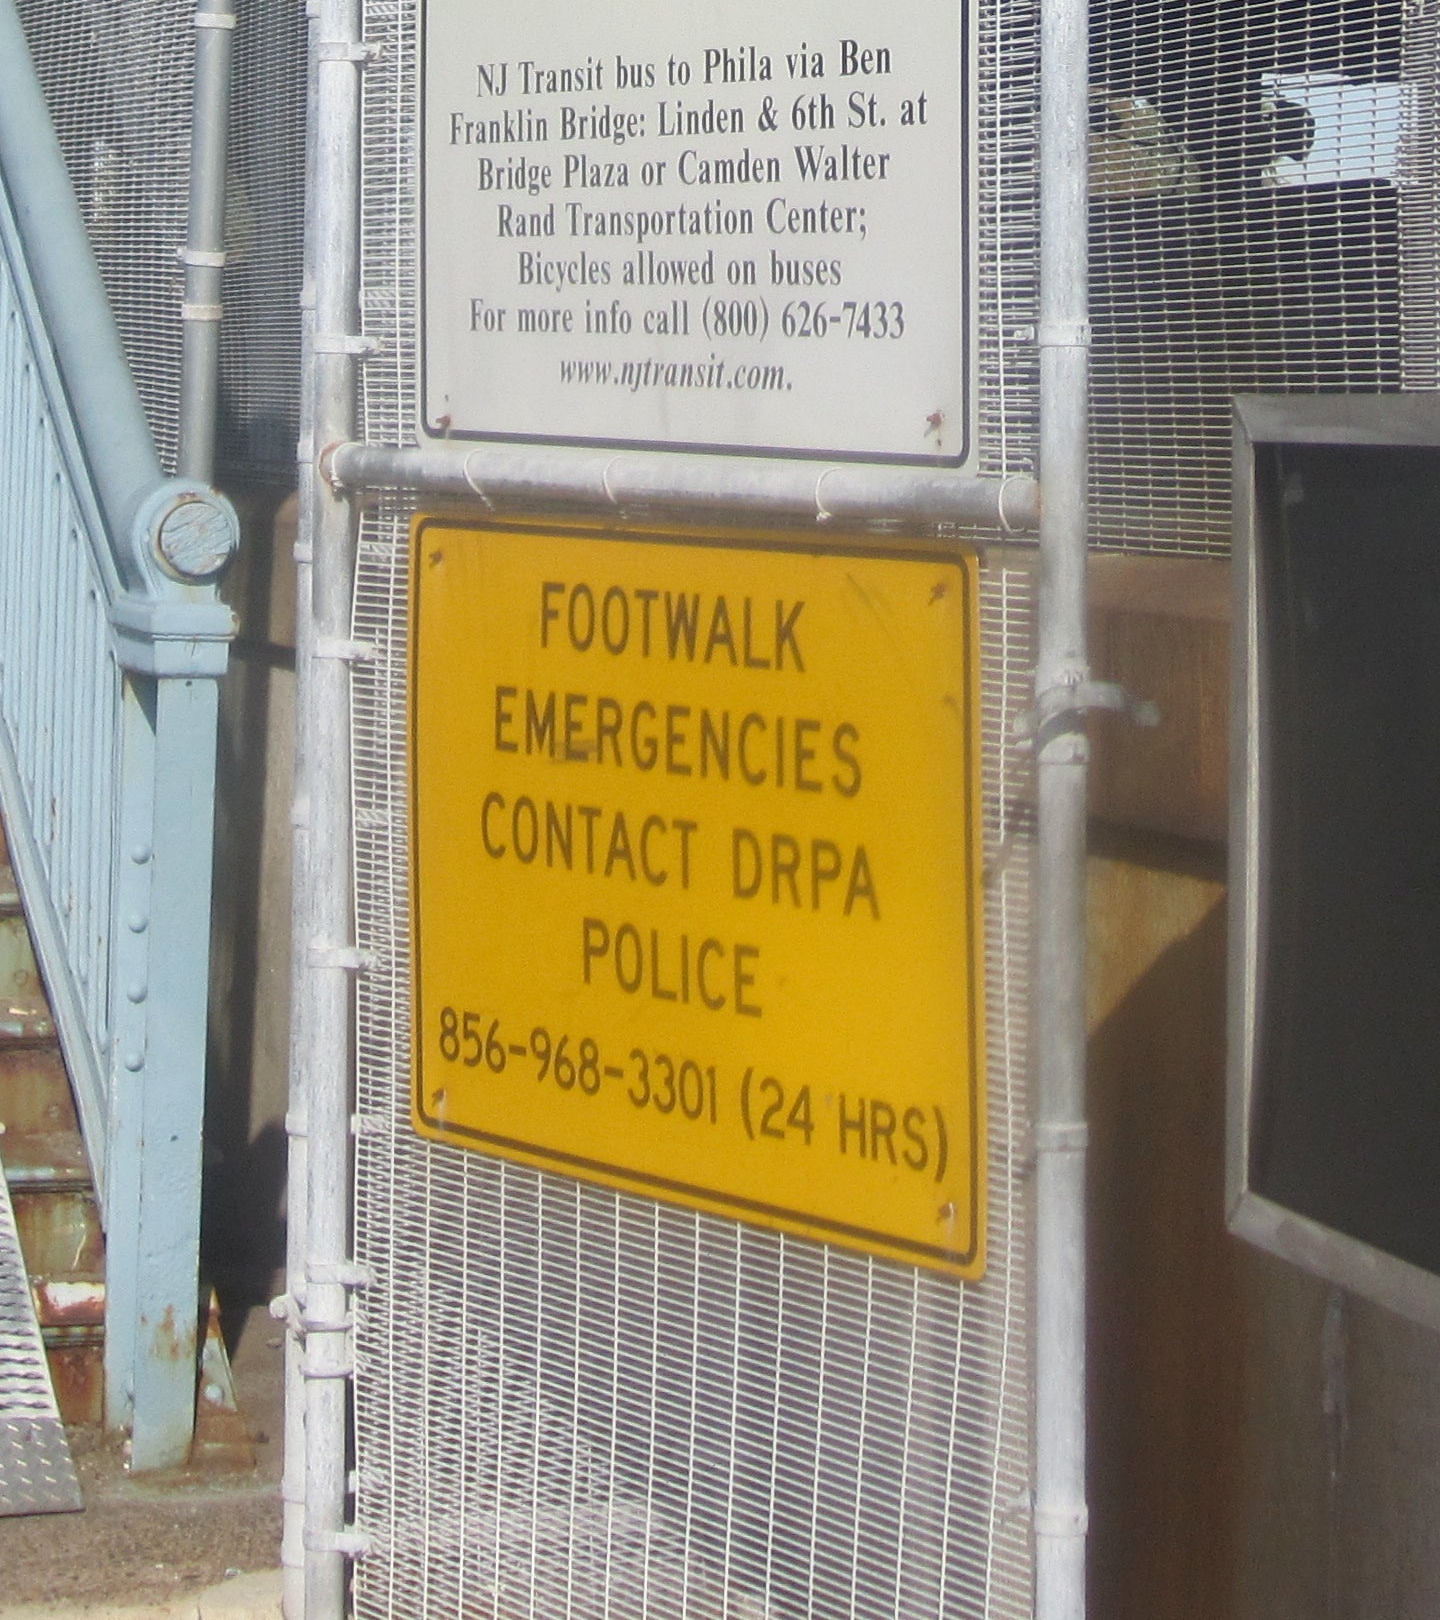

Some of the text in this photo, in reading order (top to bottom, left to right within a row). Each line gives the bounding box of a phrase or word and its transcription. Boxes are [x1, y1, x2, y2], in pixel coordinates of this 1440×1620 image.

[477, 40, 890, 97] NJ Transit bus to Phila via Ben
[450, 91, 927, 145] Franklin Bridge: Linden & 6th St. at
[479, 144, 890, 196] Bridge Plaza or Camden Walter
[498, 198, 866, 244] Rand Transportation Center;
[519, 250, 841, 293] Bicycles allowed on buses
[471, 296, 904, 342] For more info call (800) 626-7433
[541, 581, 805, 673] FOOTWALK
[495, 685, 862, 798] EMERGENCIES
[481, 791, 881, 920] CONTACT DRPA
[582, 917, 762, 1018] POLICE
[439, 1006, 948, 1183] 856-968-3301 (24 HRS)
